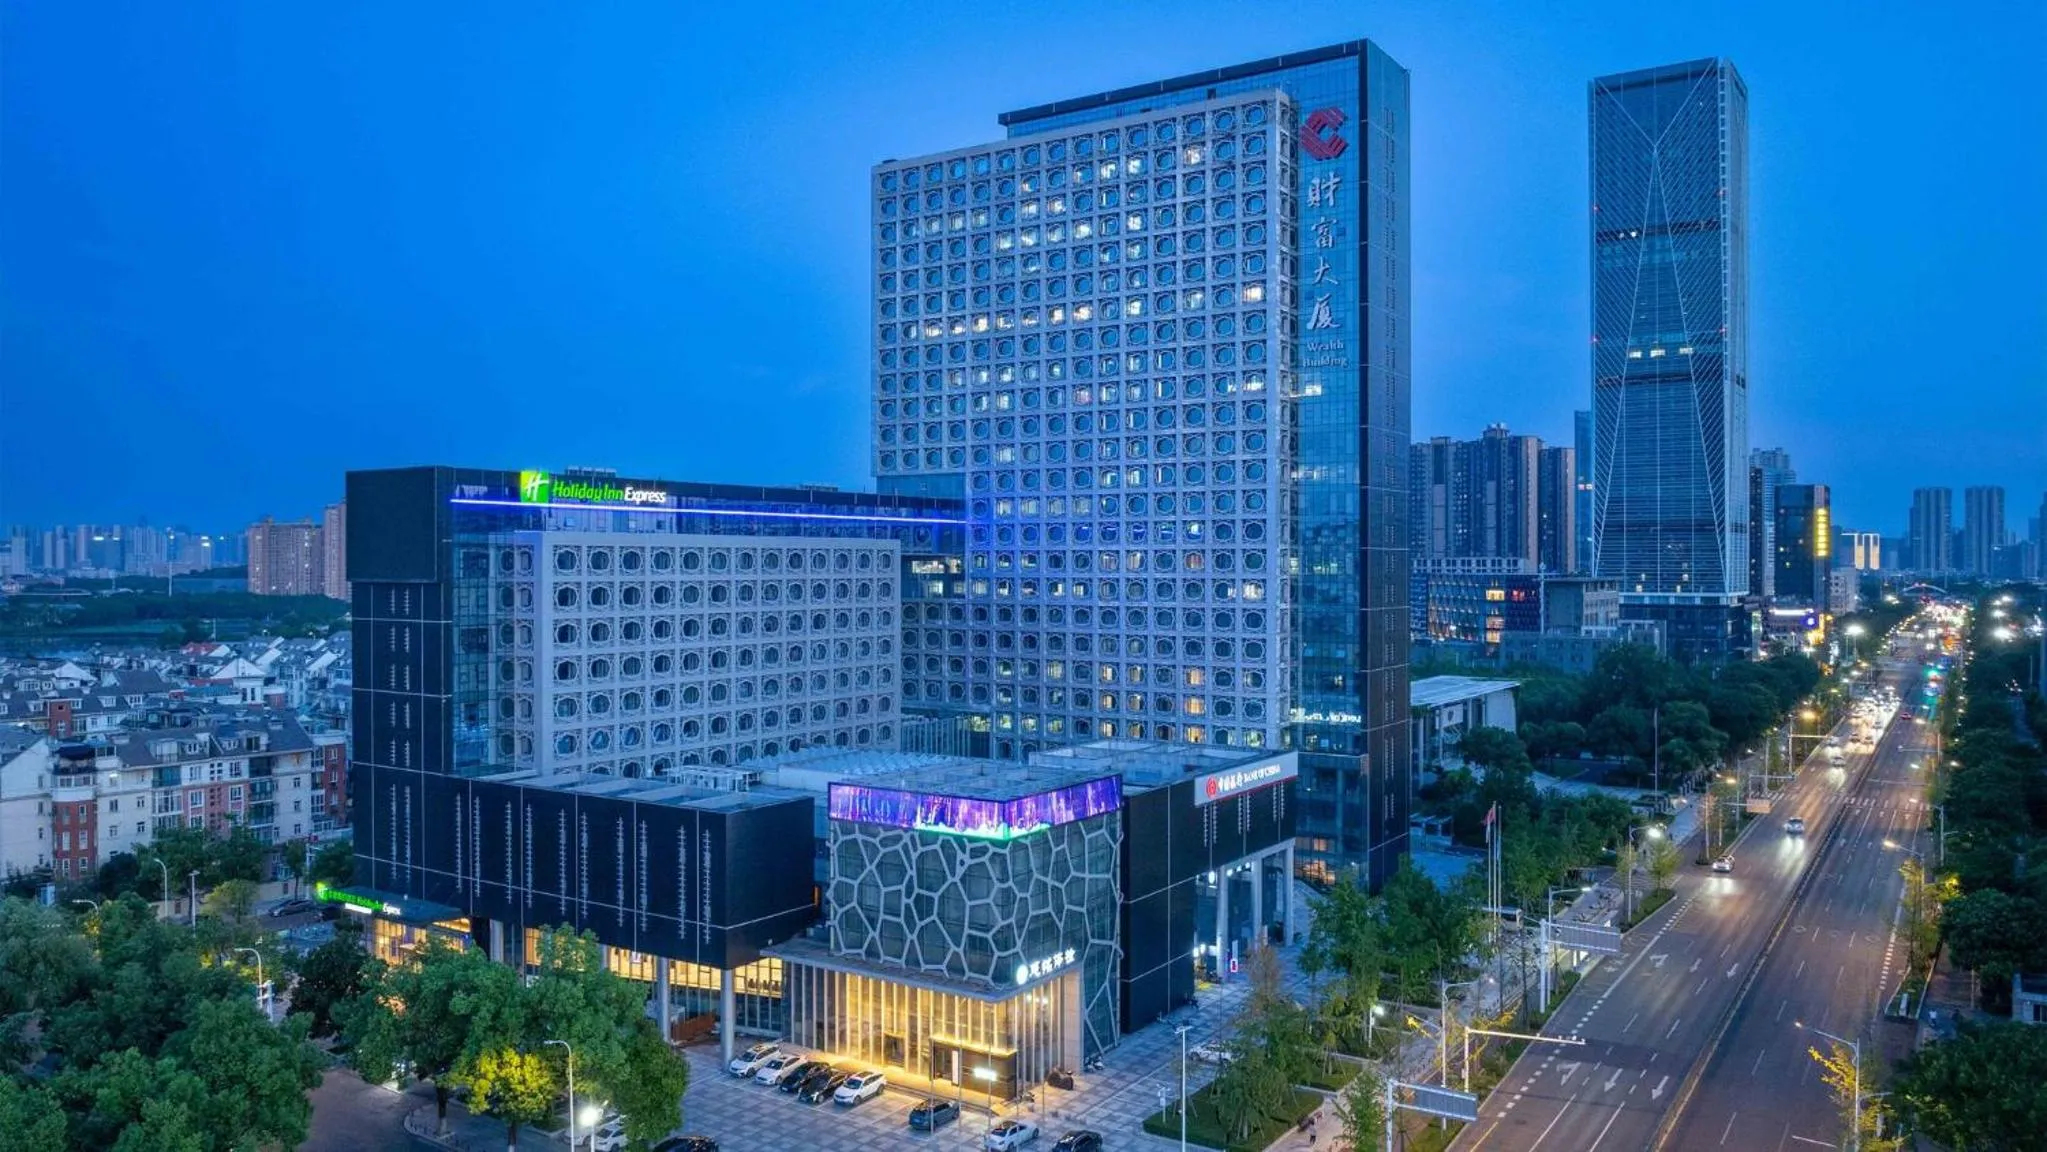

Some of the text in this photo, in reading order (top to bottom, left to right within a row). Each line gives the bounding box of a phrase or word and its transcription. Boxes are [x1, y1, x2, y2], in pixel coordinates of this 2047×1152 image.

[1306, 340, 1344, 352] Wealth
[553, 480, 666, 505] Holiday Inn Express
